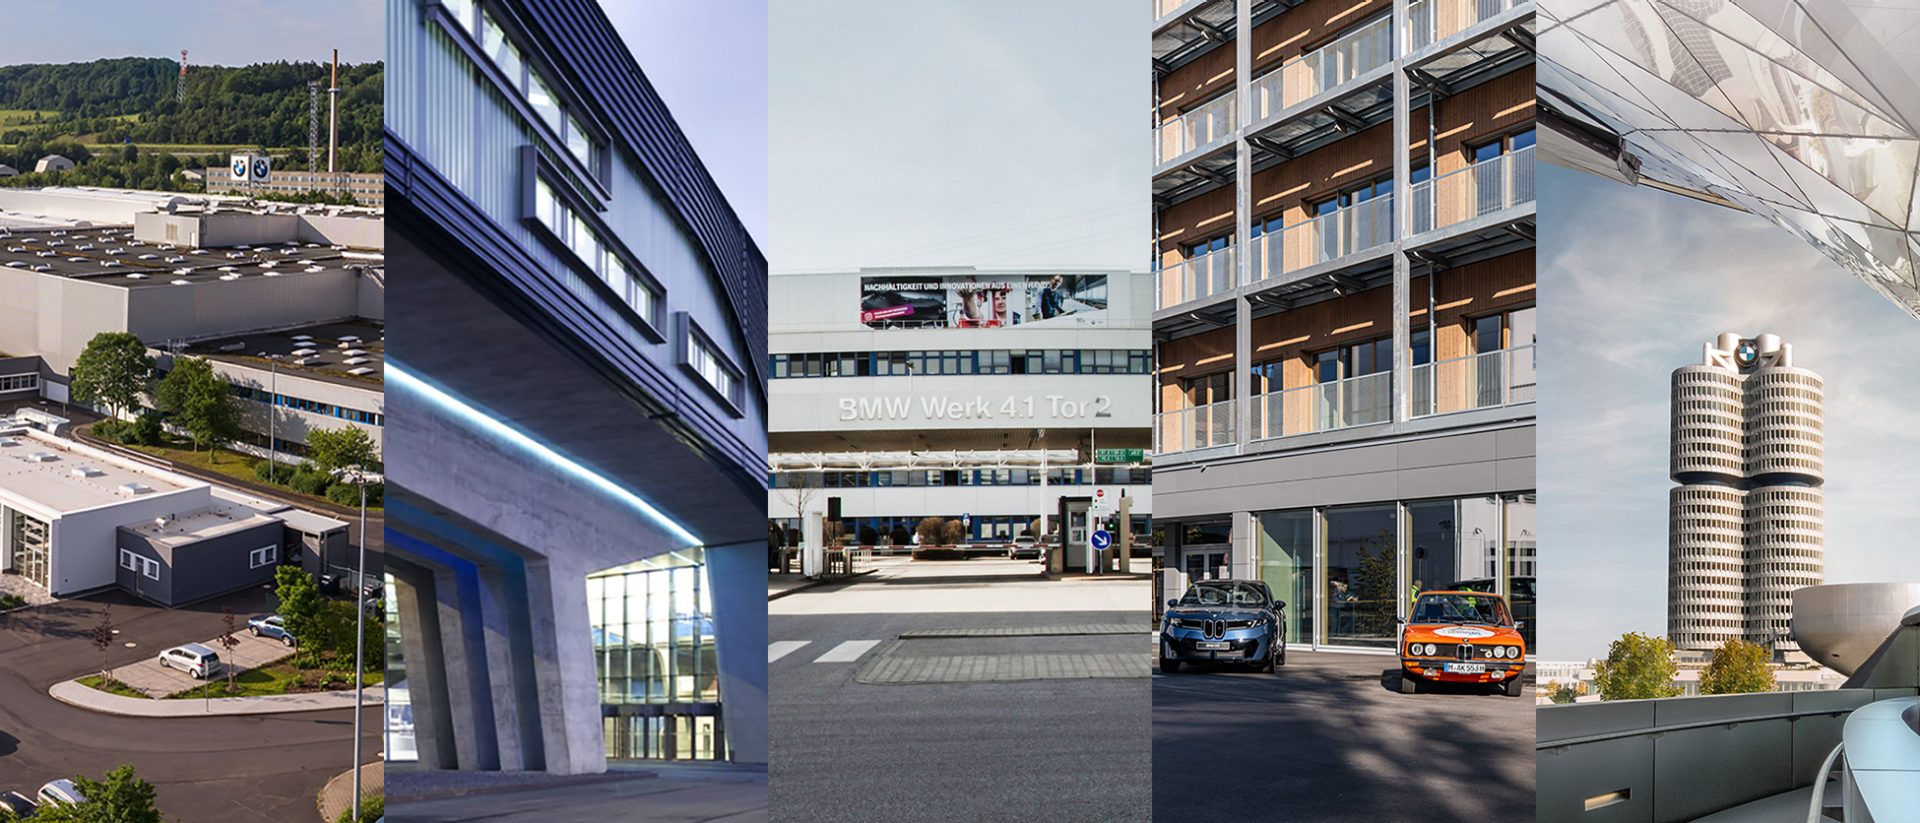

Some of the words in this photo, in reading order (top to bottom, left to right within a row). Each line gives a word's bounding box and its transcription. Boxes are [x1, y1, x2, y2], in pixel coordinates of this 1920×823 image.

[864, 283, 923, 291] NACHHALTIGKEIT
[940, 282, 991, 290] INNOVATIONEN
[992, 281, 1006, 289] AUS
[839, 396, 911, 421] BMW
[920, 395, 992, 420] Werk
[1000, 395, 1034, 419] 4.1
[1045, 395, 1089, 419] Tor
[1094, 395, 1111, 418] 2
